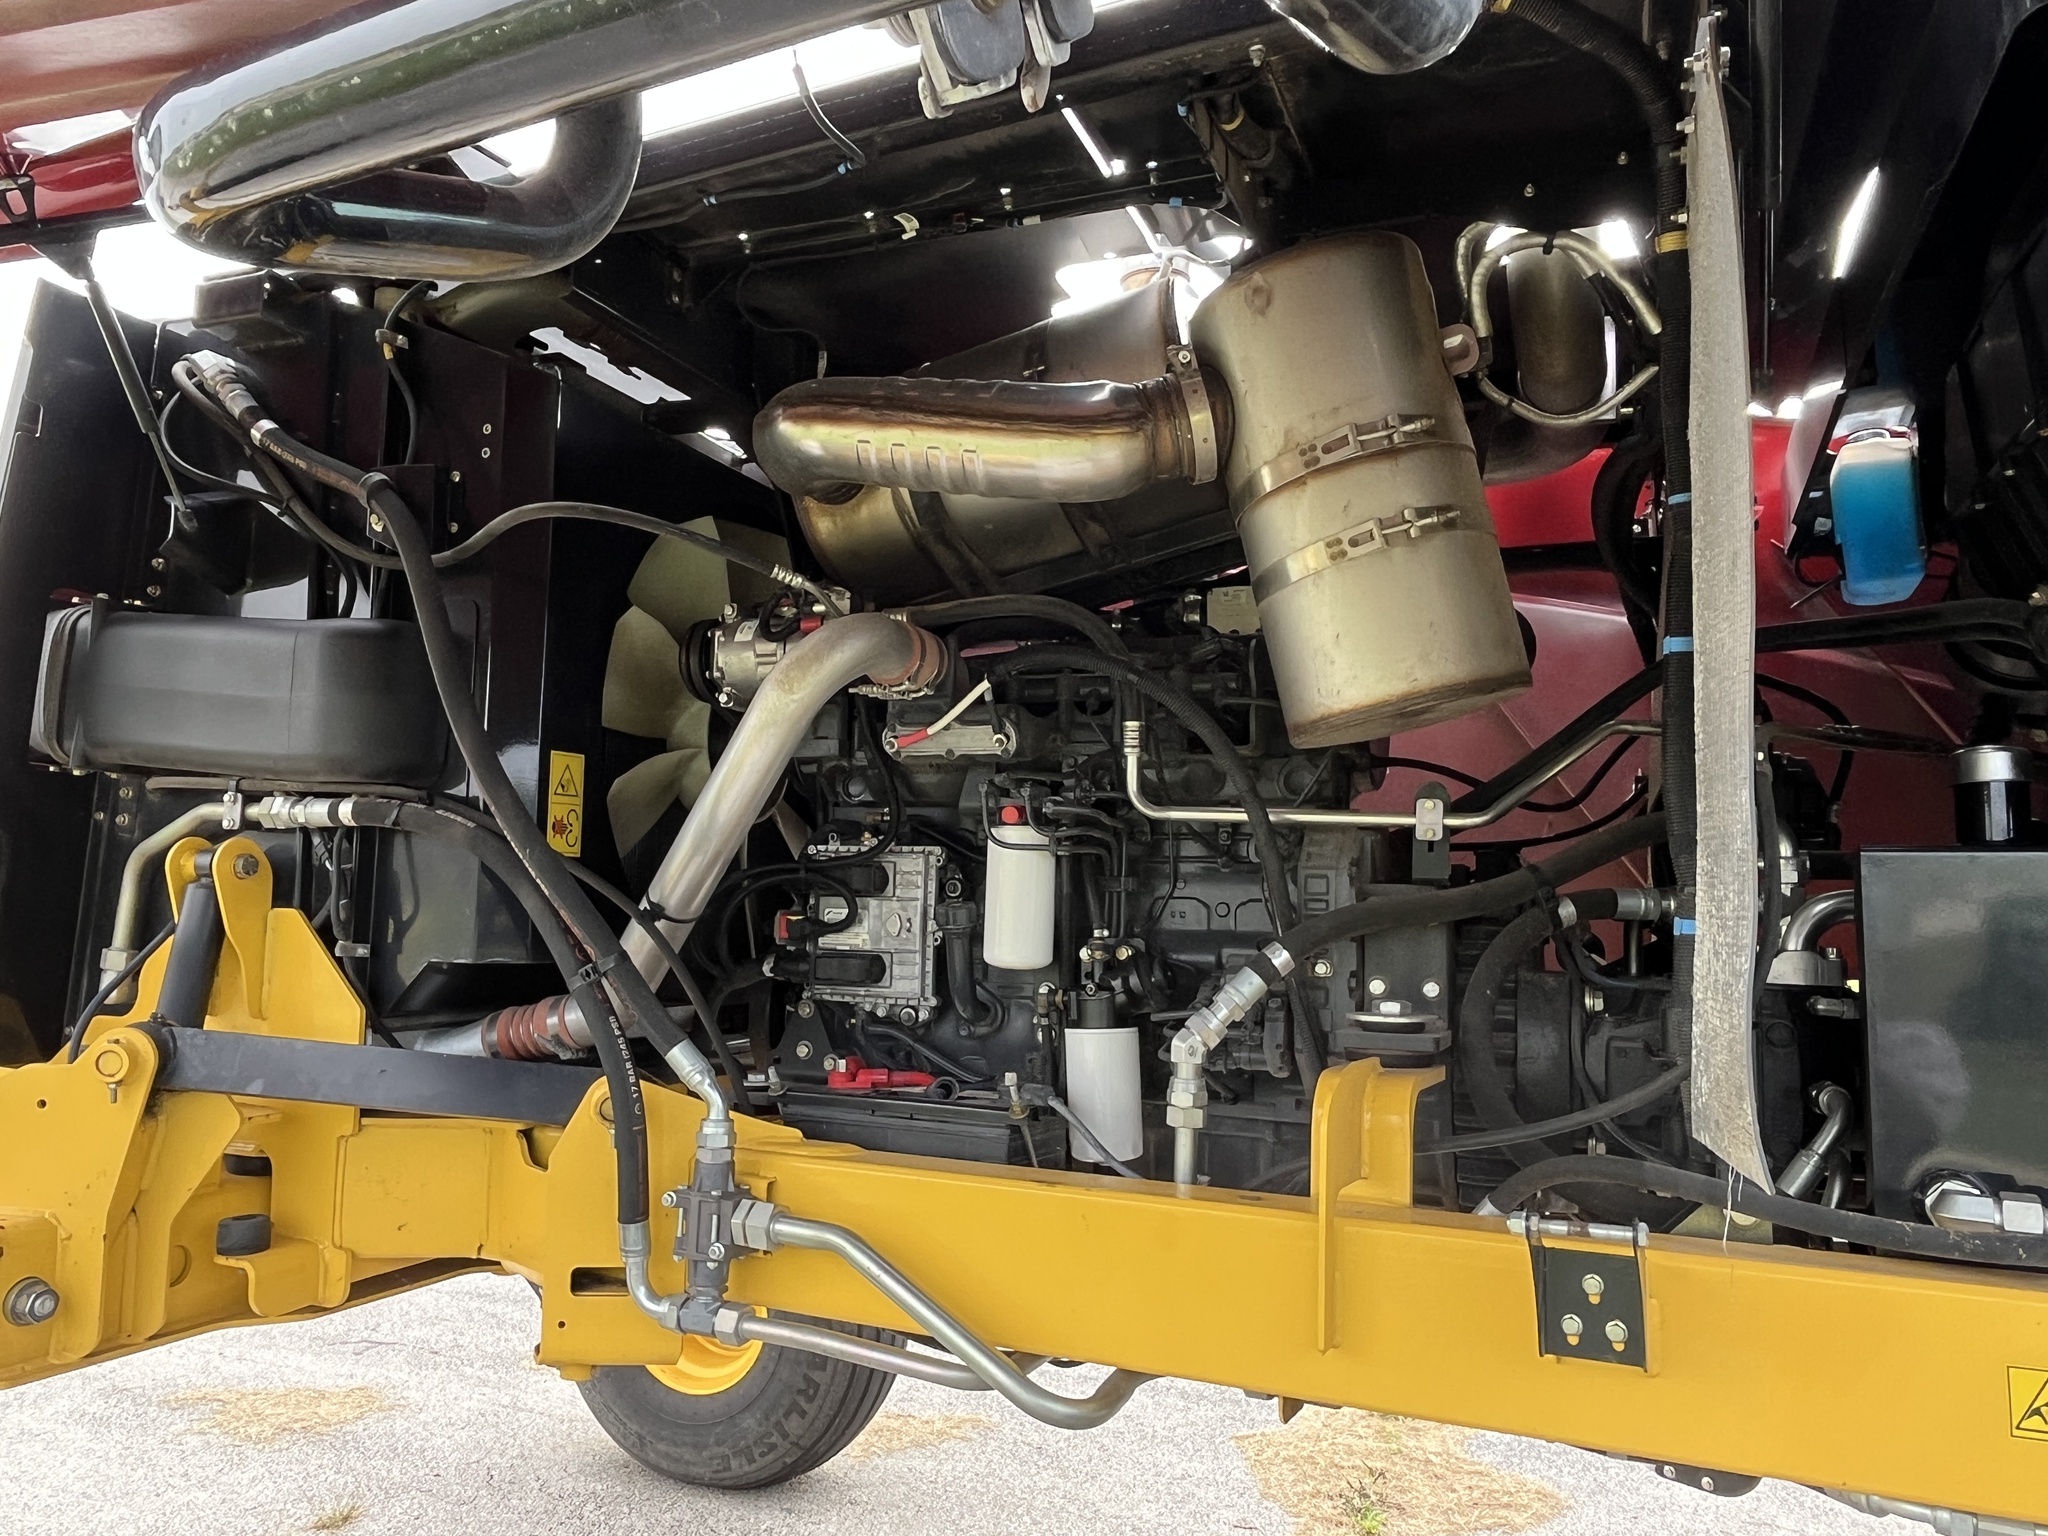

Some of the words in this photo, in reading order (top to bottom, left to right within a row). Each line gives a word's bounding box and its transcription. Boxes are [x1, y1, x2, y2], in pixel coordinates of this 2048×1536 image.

[625, 1061, 637, 1083] BAR
[631, 1086, 639, 1098] 17
[709, 1355, 829, 1474] RLISLE
